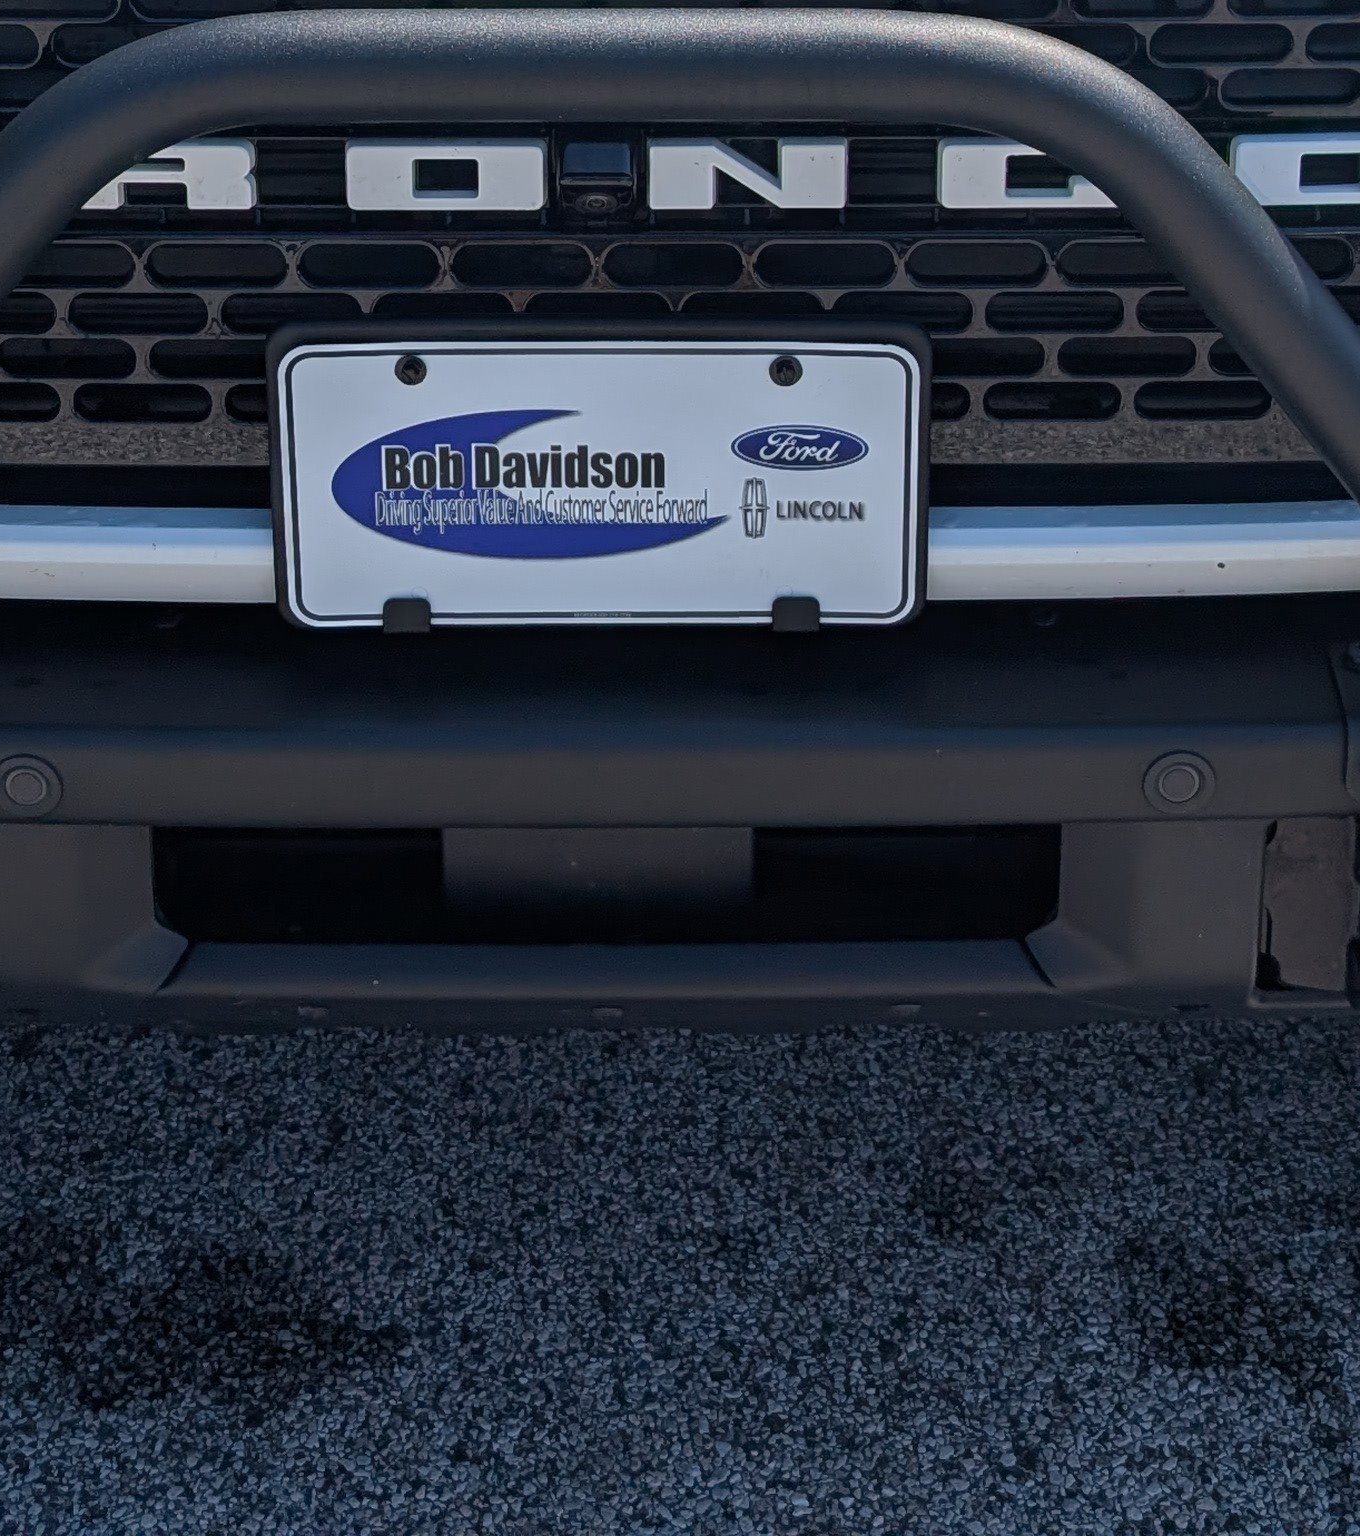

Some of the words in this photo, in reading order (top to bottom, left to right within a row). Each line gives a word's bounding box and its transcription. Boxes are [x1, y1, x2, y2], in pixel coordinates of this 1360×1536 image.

[758, 431, 841, 462] Ford
[383, 445, 465, 490] Bob
[473, 444, 666, 490] Davidson
[375, 491, 422, 534] Driving
[423, 490, 478, 534] Superior
[478, 490, 515, 524] Value
[516, 490, 543, 524] And
[544, 490, 608, 524] Customer
[608, 491, 655, 524] Service
[775, 500, 865, 521] LINCOLN
